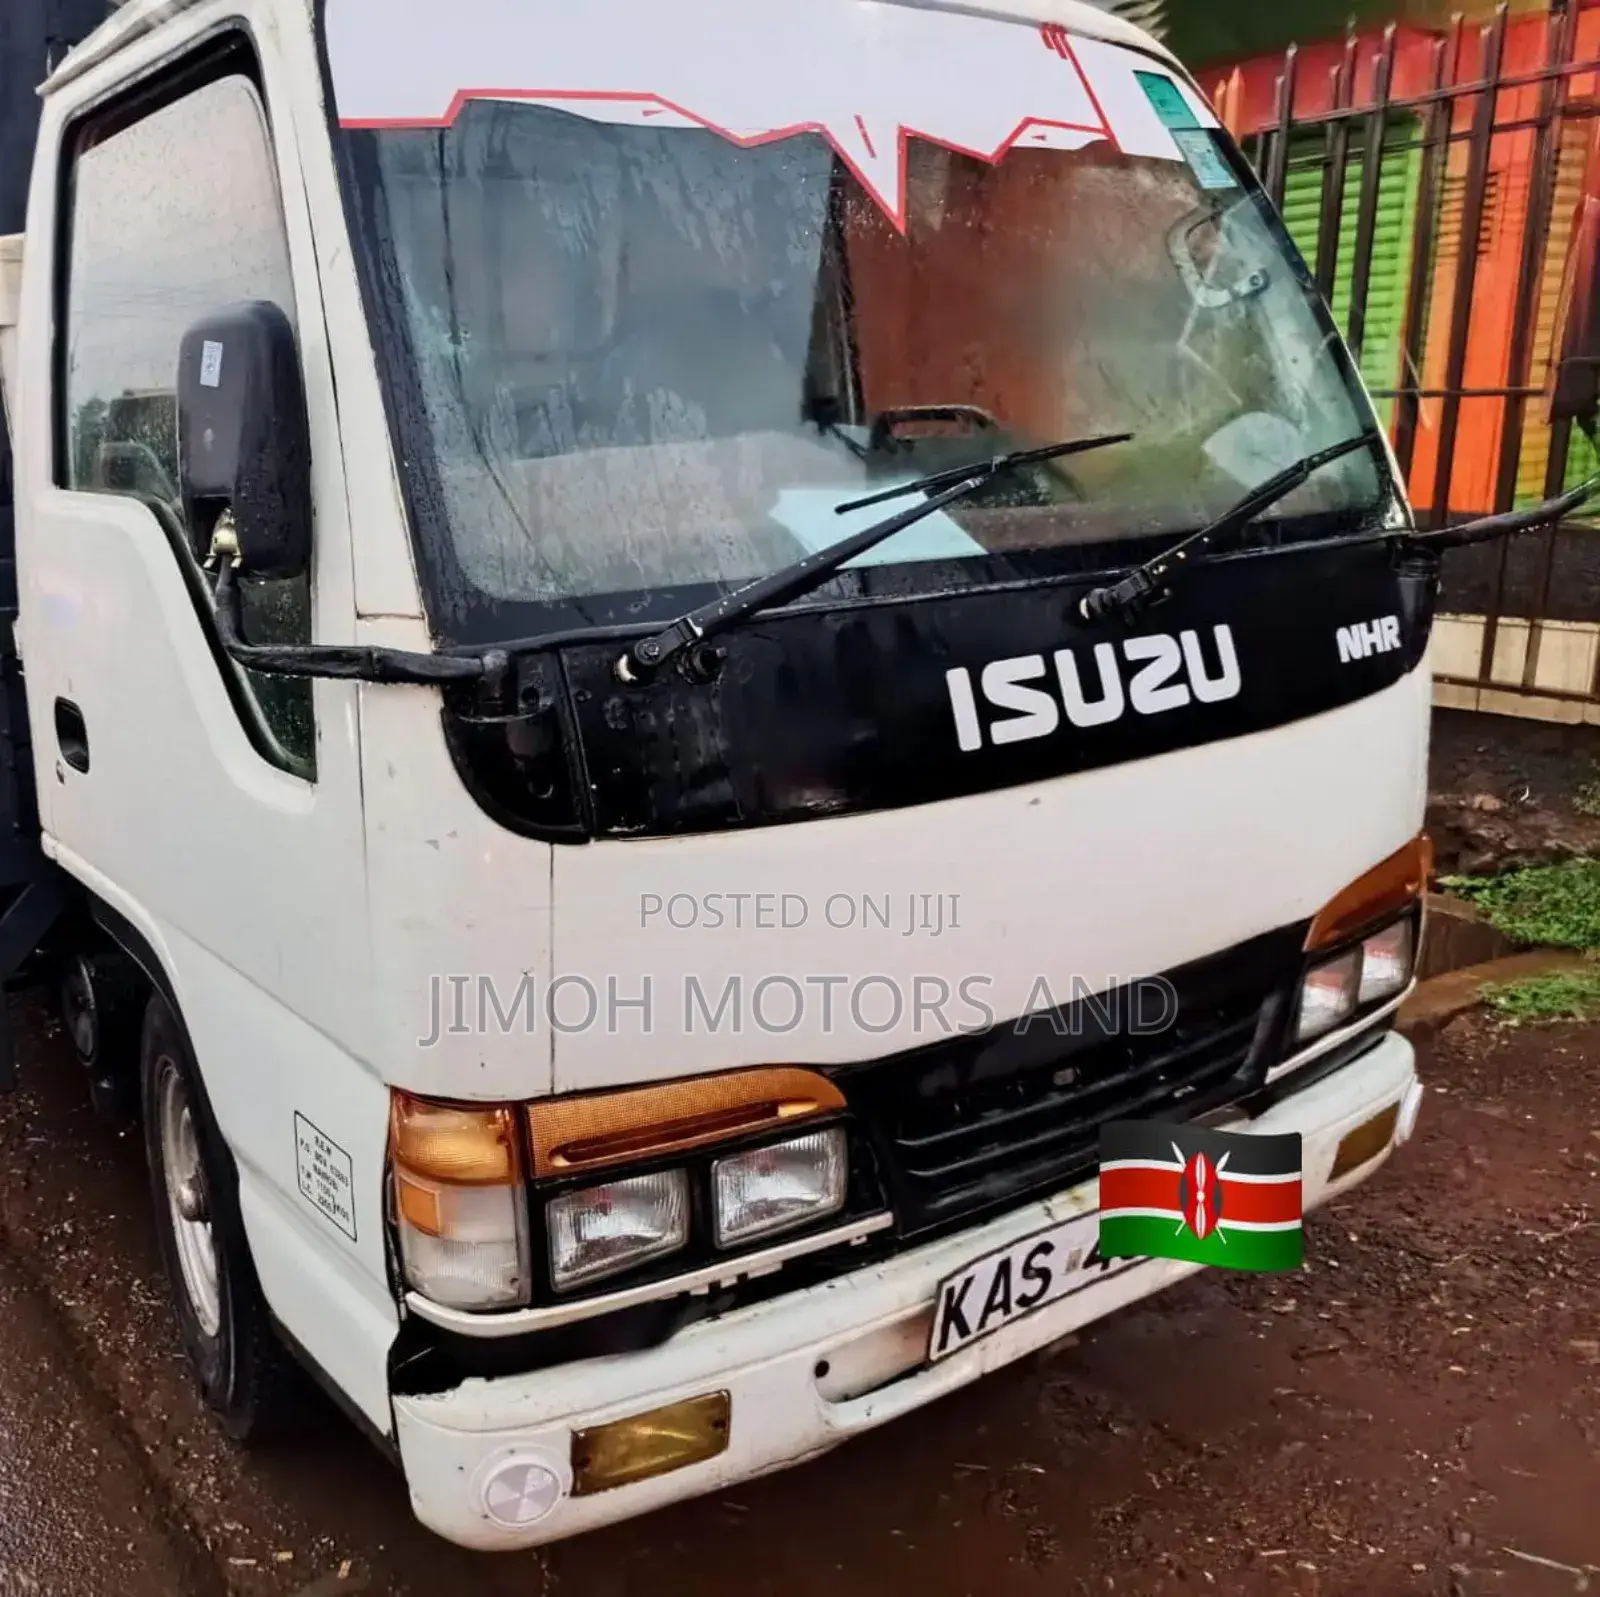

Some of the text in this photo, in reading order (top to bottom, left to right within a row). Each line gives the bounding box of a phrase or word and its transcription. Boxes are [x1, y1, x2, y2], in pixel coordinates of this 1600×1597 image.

[945, 624, 1242, 752] ISUZU
[1335, 615, 1402, 663] NHR
[937, 1241, 1056, 1352] KAS
